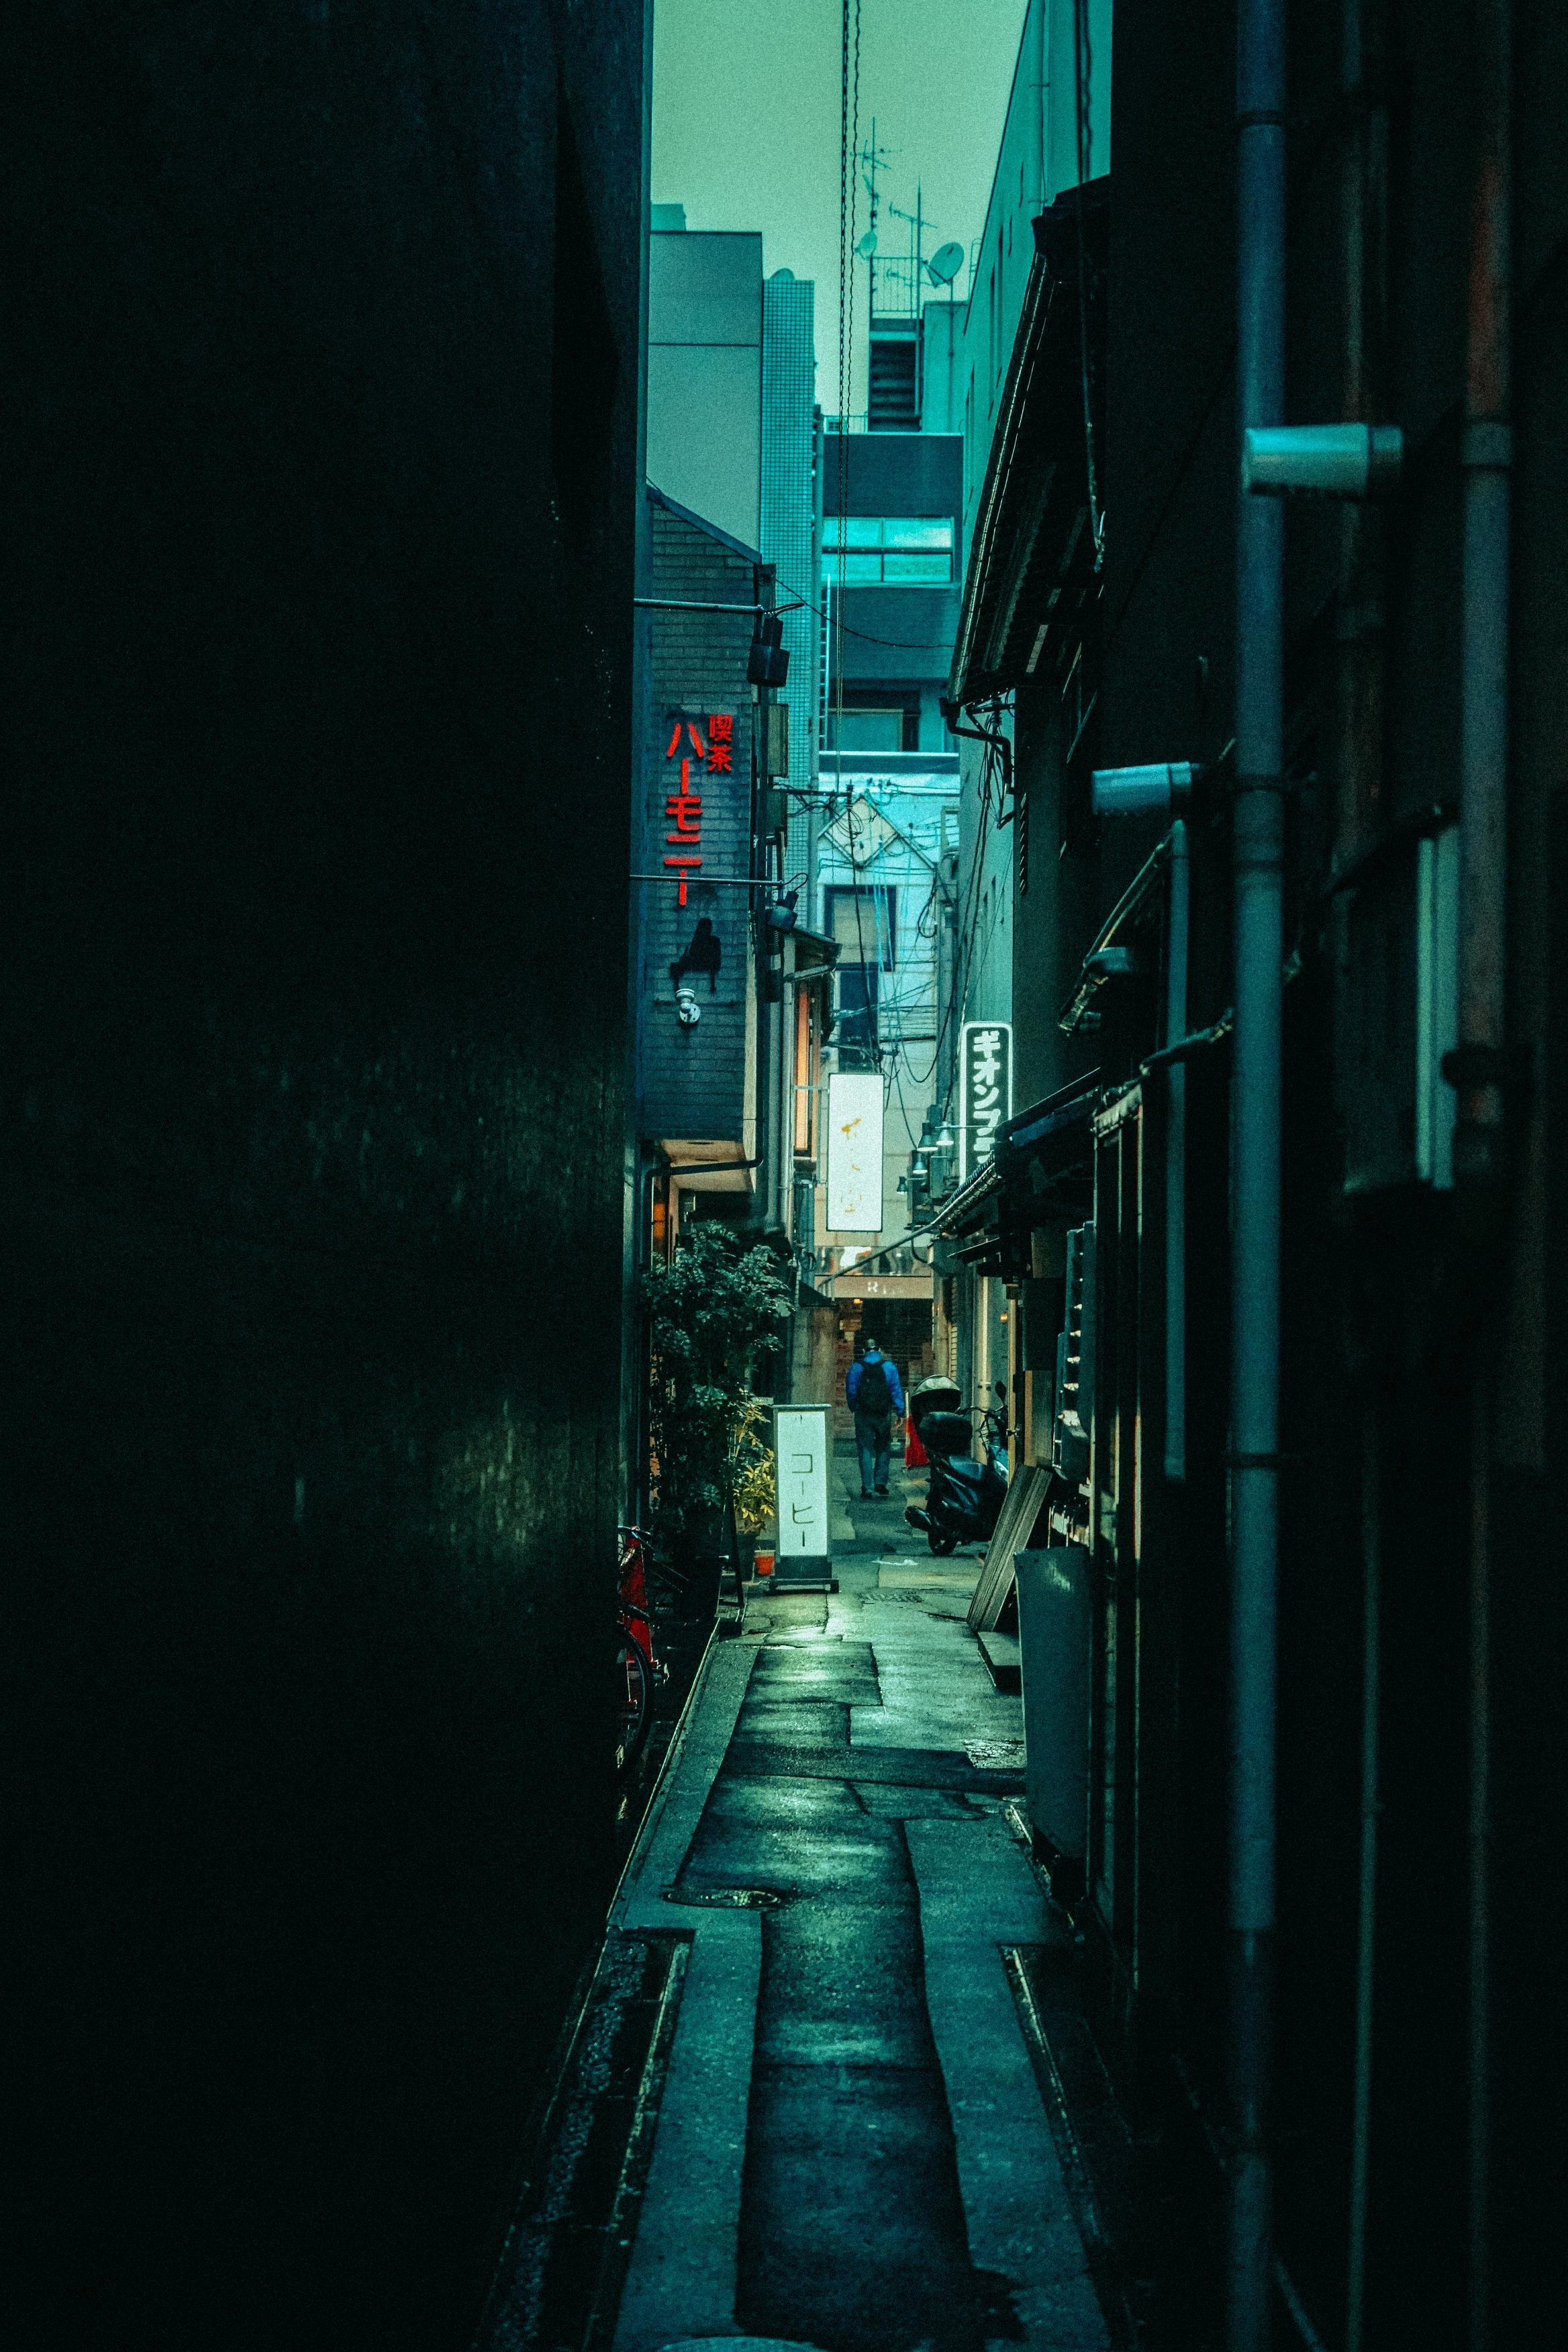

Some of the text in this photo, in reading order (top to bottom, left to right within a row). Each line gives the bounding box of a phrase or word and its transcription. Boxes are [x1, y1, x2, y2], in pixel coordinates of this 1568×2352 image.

[708, 714, 733, 772] 喫茶
[664, 722, 704, 906] ハーモニー
[791, 1453, 814, 1547] コーヒー
